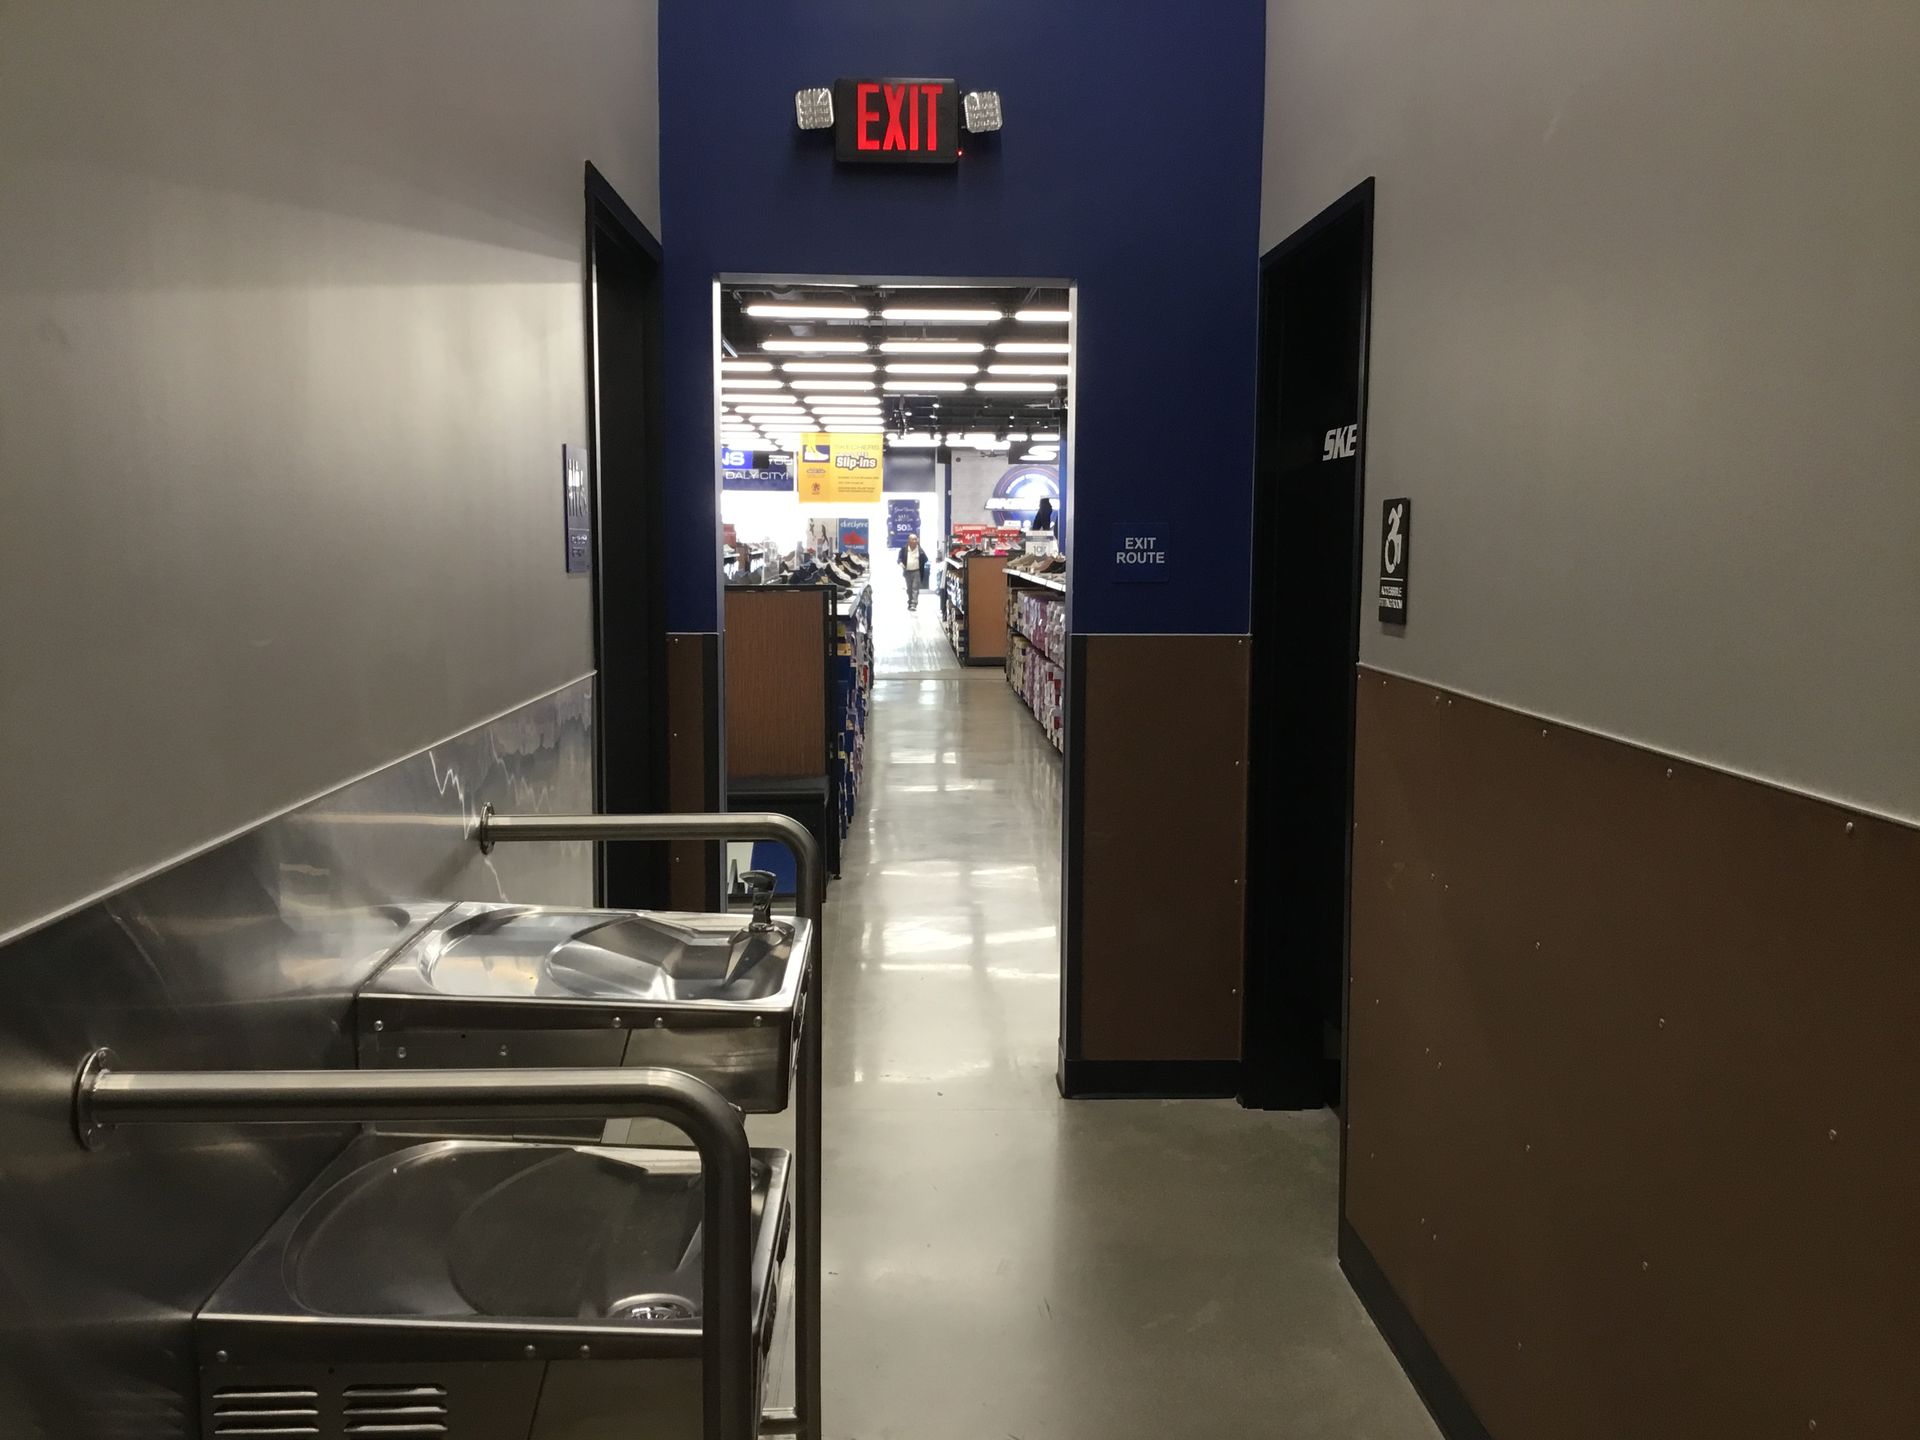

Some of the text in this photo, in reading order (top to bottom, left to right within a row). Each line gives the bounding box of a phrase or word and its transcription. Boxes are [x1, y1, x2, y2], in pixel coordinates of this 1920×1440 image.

[857, 82, 943, 151] EXIT
[1322, 423, 1358, 462] SKE
[835, 456, 877, 470] Slip-ins
[725, 471, 789, 480] DALY CITY!
[1125, 537, 1157, 550] EXIT
[1116, 551, 1165, 564] ROUTE
